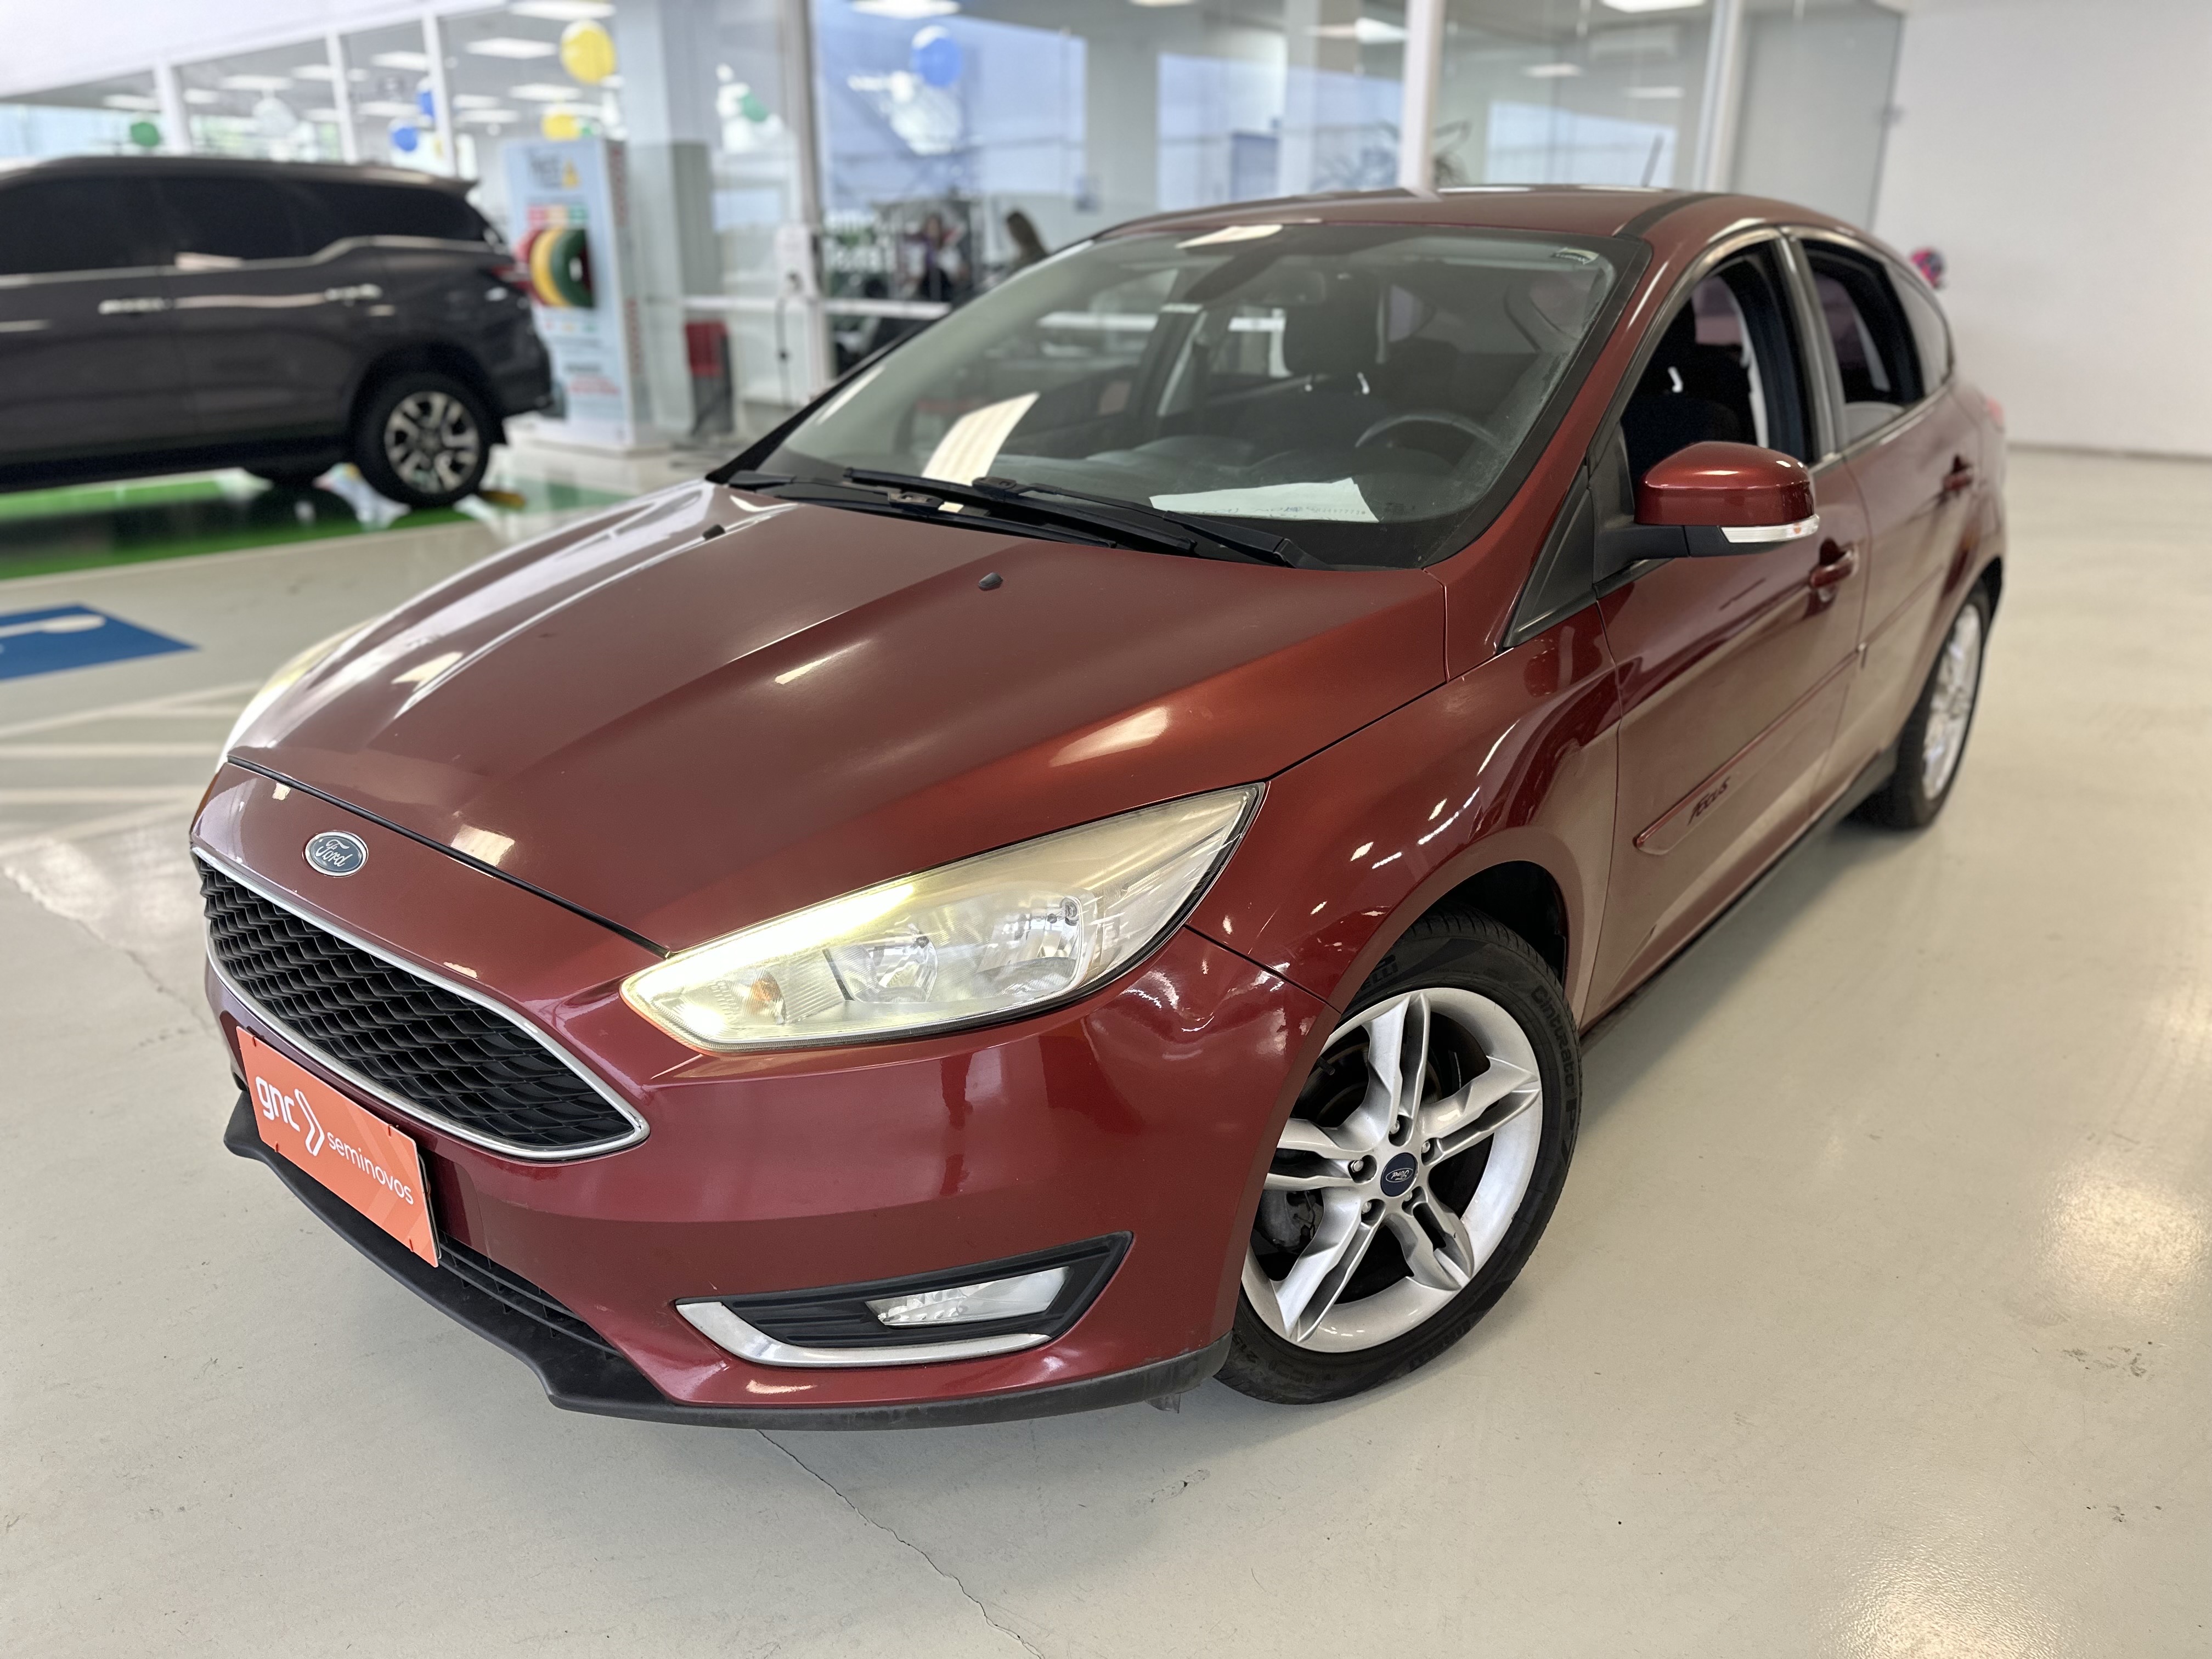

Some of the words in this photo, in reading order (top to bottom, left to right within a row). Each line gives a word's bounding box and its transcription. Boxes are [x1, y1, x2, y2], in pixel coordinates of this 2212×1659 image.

[315, 839, 353, 867] Ford
[255, 1076, 300, 1132] gnc
[327, 1132, 414, 1205] seminovos
[1390, 1170, 1409, 1181] Ford
